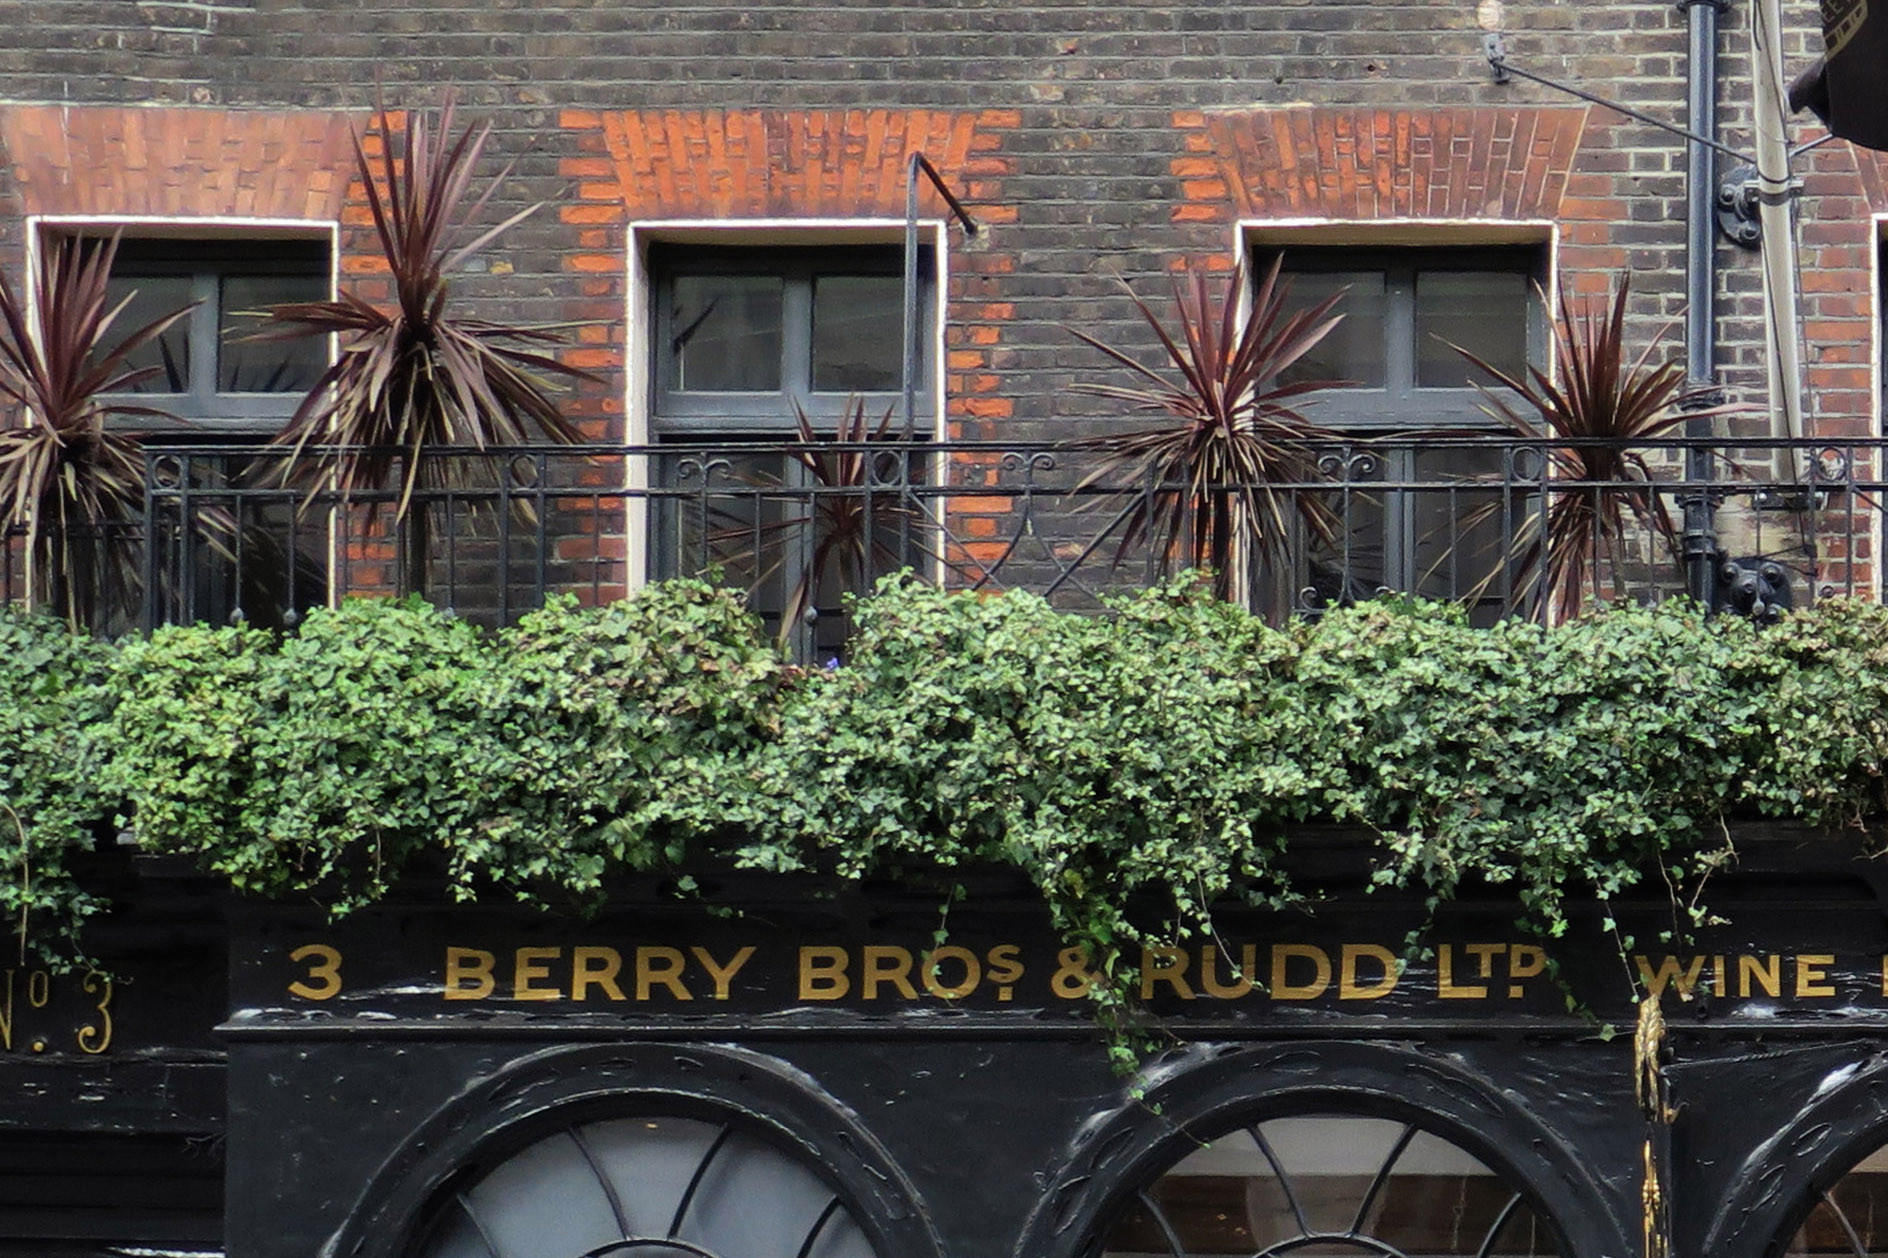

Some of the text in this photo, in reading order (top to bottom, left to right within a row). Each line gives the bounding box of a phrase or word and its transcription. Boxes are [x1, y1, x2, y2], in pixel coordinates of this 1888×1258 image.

[288, 945, 341, 1000] 3
[444, 947, 754, 1001] BERRY
[1051, 946, 1103, 999] &
[1142, 944, 1398, 1000] RUDD
[1635, 954, 1836, 997] WINE
[79, 970, 113, 1053] 3
